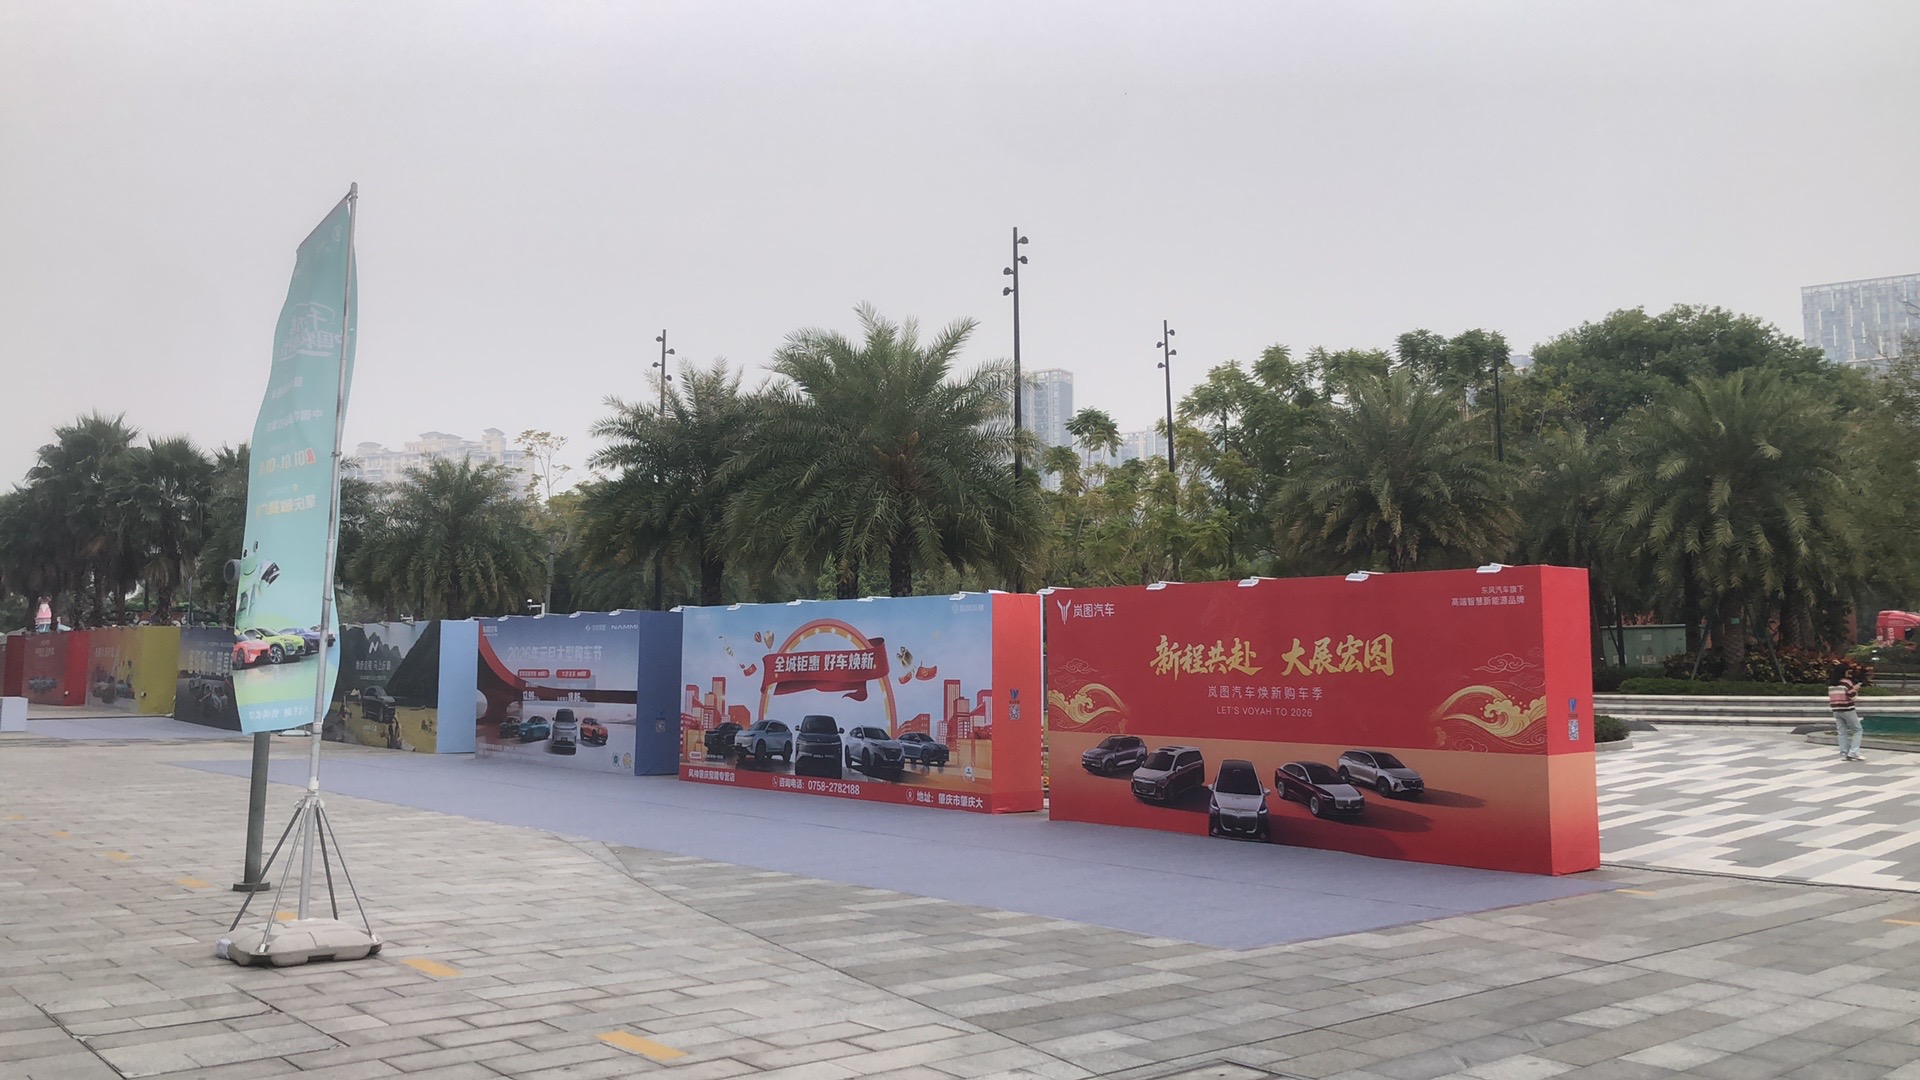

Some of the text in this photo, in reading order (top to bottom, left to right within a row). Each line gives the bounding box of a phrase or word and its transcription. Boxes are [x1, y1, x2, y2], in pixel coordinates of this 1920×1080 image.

[1481, 585, 1525, 594] 东风汽车旗下
[1451, 595, 1525, 607] 高端智慧新能源品牌
[1073, 603, 1115, 618] 岚图汽车
[507, 645, 603, 663] 2026年元旦大型购车节
[1149, 633, 1395, 681] 新程共赴 大展宏图
[774, 652, 874, 673] 全城钜惠 好车焕新
[1208, 685, 1323, 700] 岚图汽车焕新购车季
[1216, 706, 1313, 718] LET'S VOYAH TO 2026
[807, 780, 860, 795] 0758-2782188
